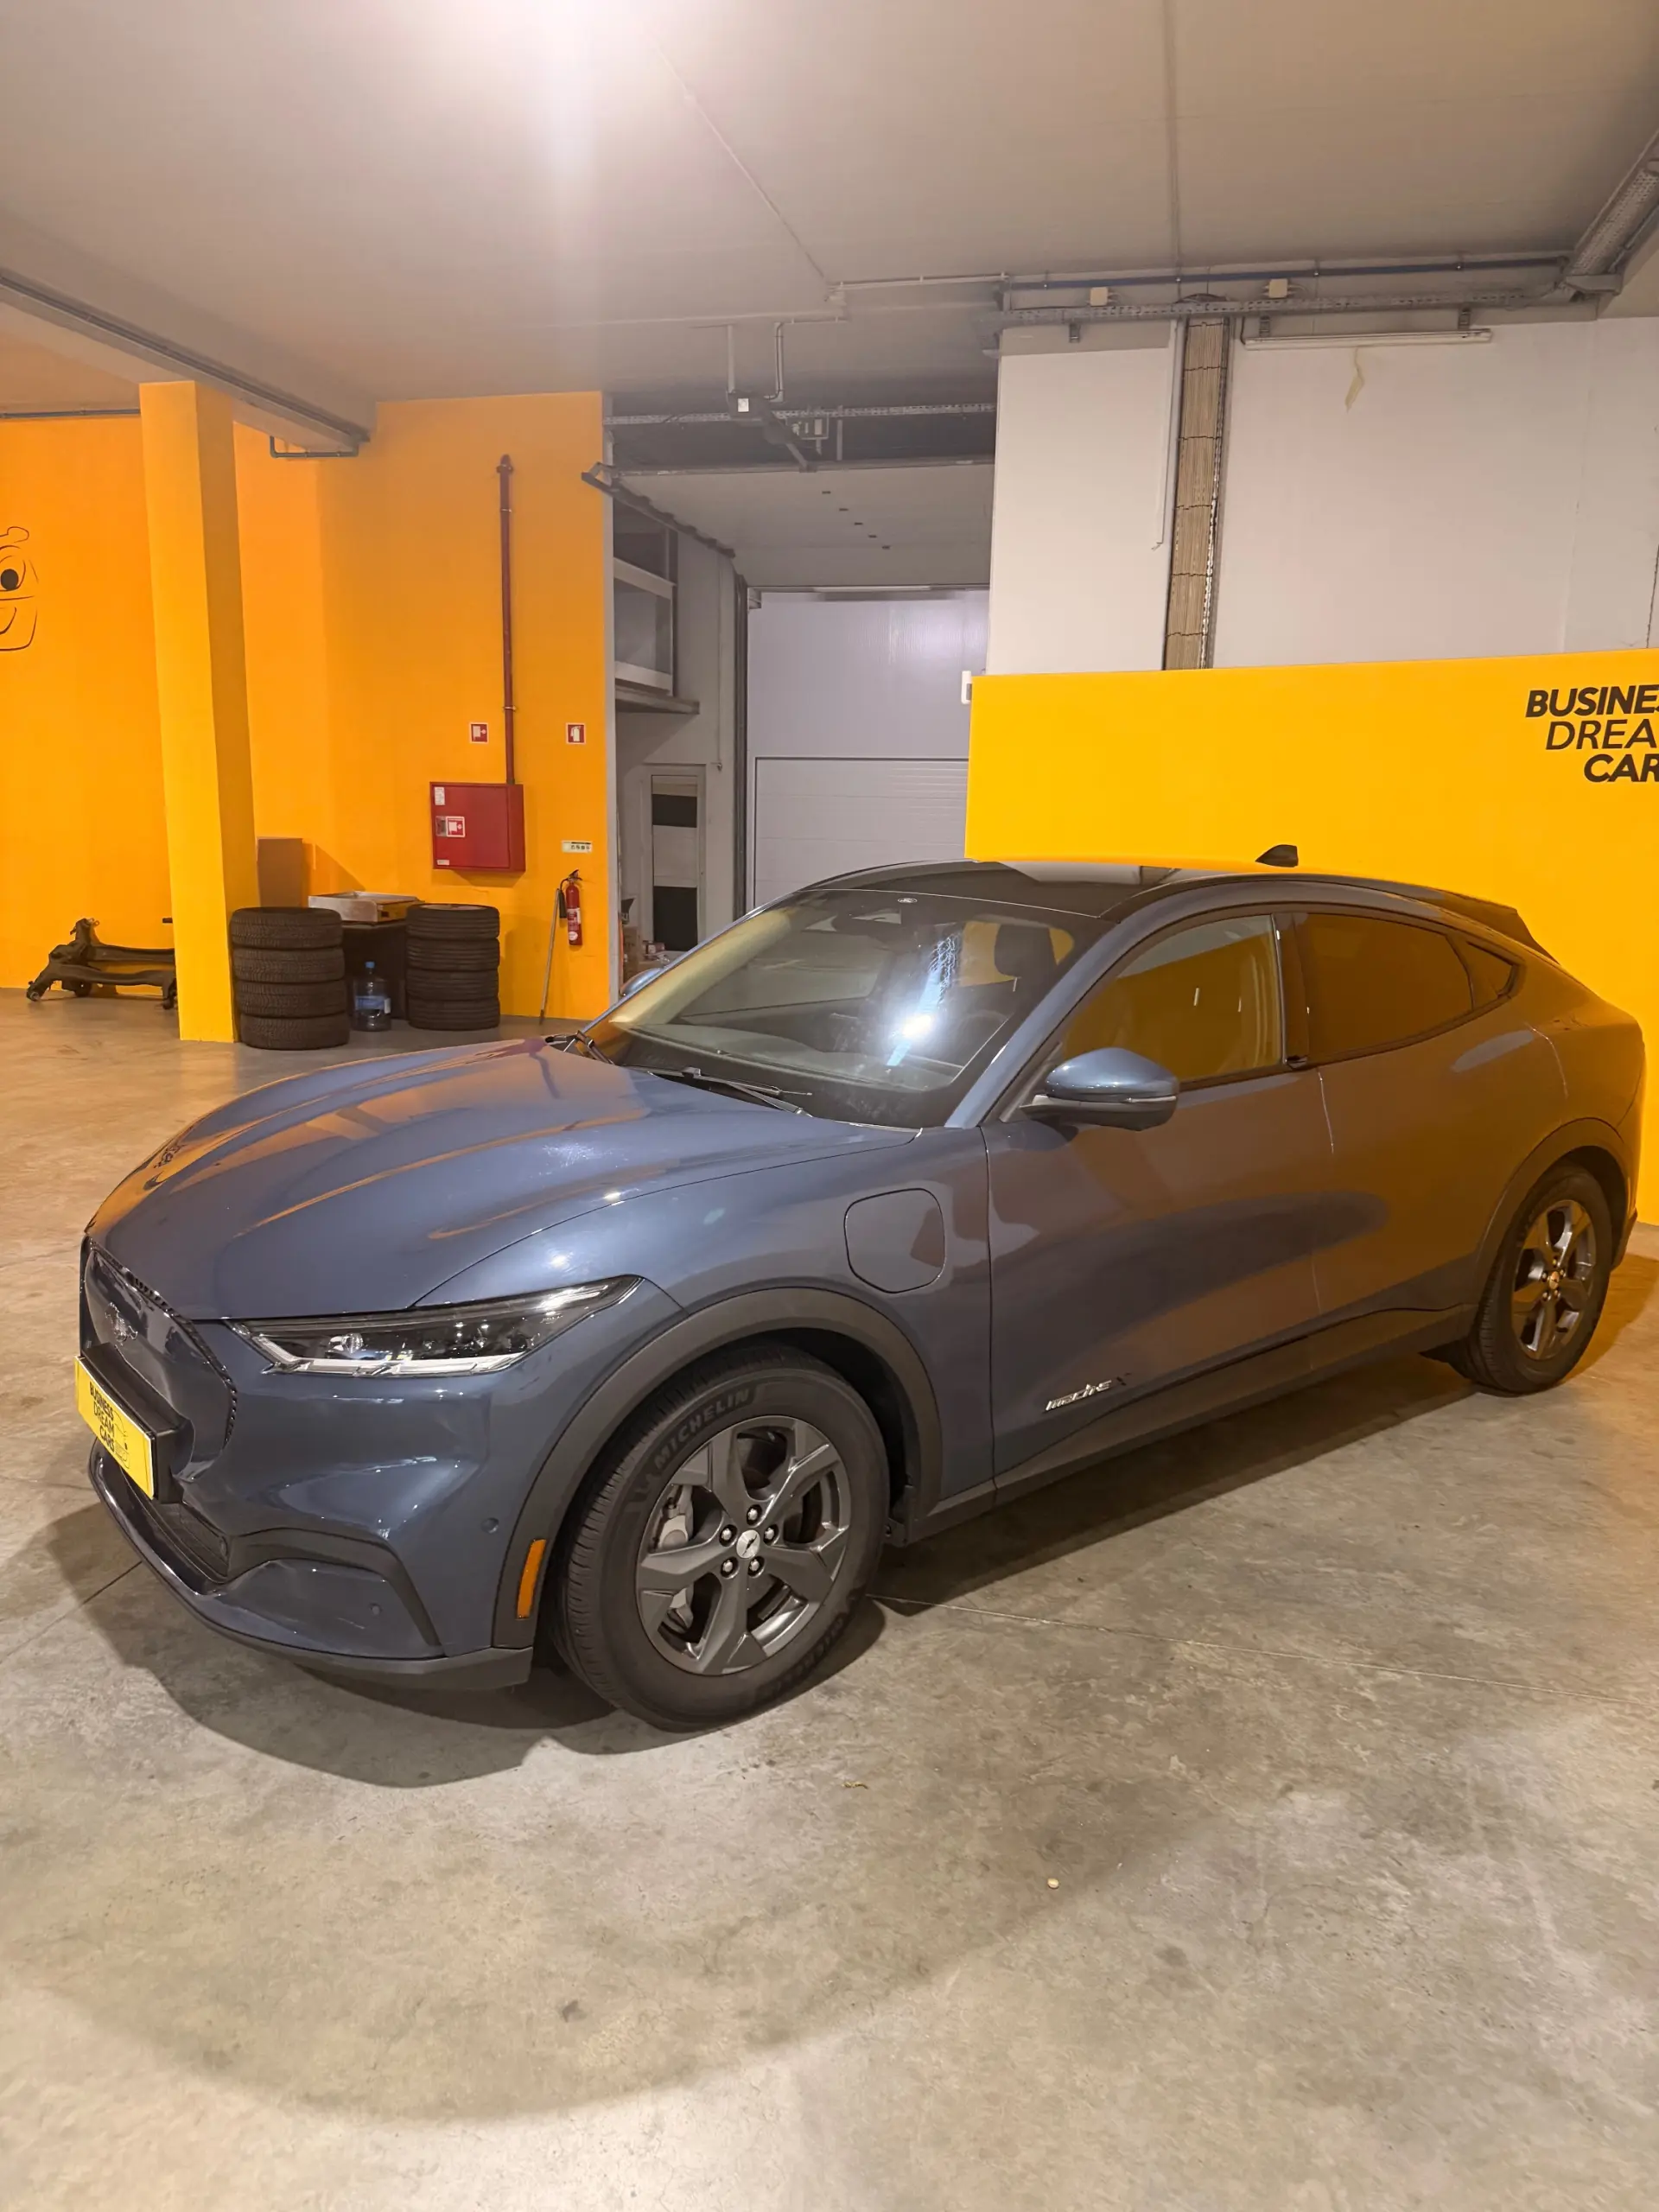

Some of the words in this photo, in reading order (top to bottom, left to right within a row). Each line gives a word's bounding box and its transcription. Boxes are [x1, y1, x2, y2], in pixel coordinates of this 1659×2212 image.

[1525, 683, 1659, 717] BUSINE
[1545, 718, 1657, 750] DREA
[1583, 753, 1659, 783] CAR
[89, 1381, 114, 1421] BUSINESS
[93, 1402, 115, 1438] DREAM
[653, 1388, 750, 1470] MICHELIN
[99, 1425, 115, 1452] CARS
